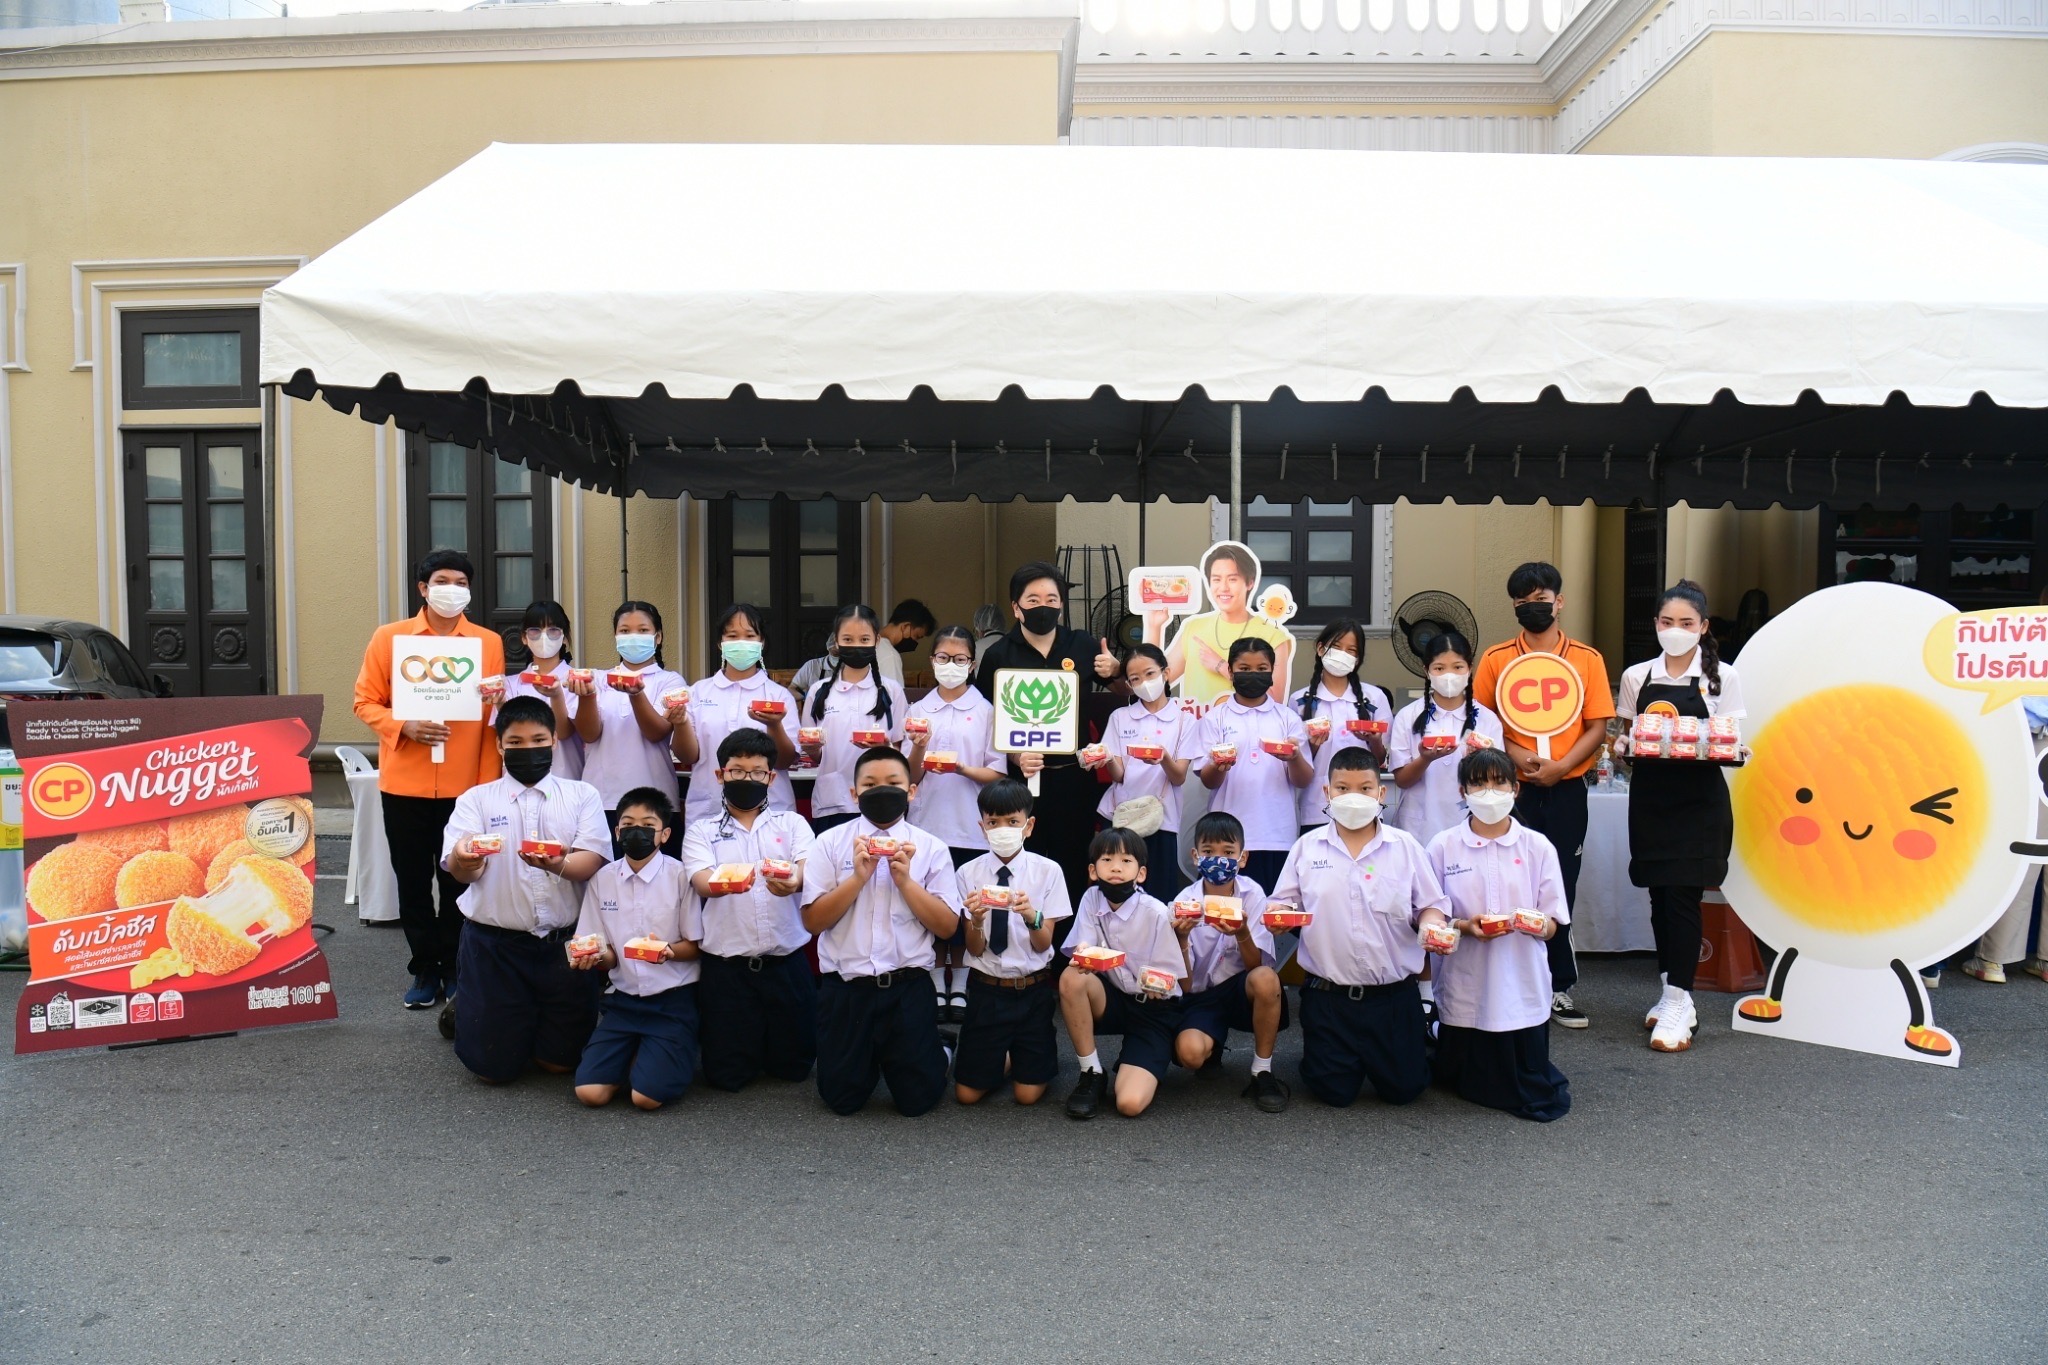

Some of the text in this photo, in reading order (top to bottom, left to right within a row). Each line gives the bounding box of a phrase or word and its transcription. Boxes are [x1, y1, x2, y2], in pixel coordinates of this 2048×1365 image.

[1957, 652, 2048, 679] โปรตีน
[1508, 677, 1570, 713] CP
[26, 727, 49, 736] Ready
[110, 724, 139, 733] Nuggets
[94, 731, 118, 739] Brand)
[1009, 730, 1061, 747] CPF
[145, 740, 240, 771] Chicken
[100, 746, 260, 808] Nugget
[216, 776, 260, 797] นักเก็ตไก่
[39, 779, 85, 803] CP
[257, 811, 295, 836] อันดับ 1
[53, 914, 158, 954] ดับเบิ้ลชีส
[290, 986, 314, 1005] 160
[315, 982, 331, 993] กรัม
[248, 997, 289, 1010] Net Weight
